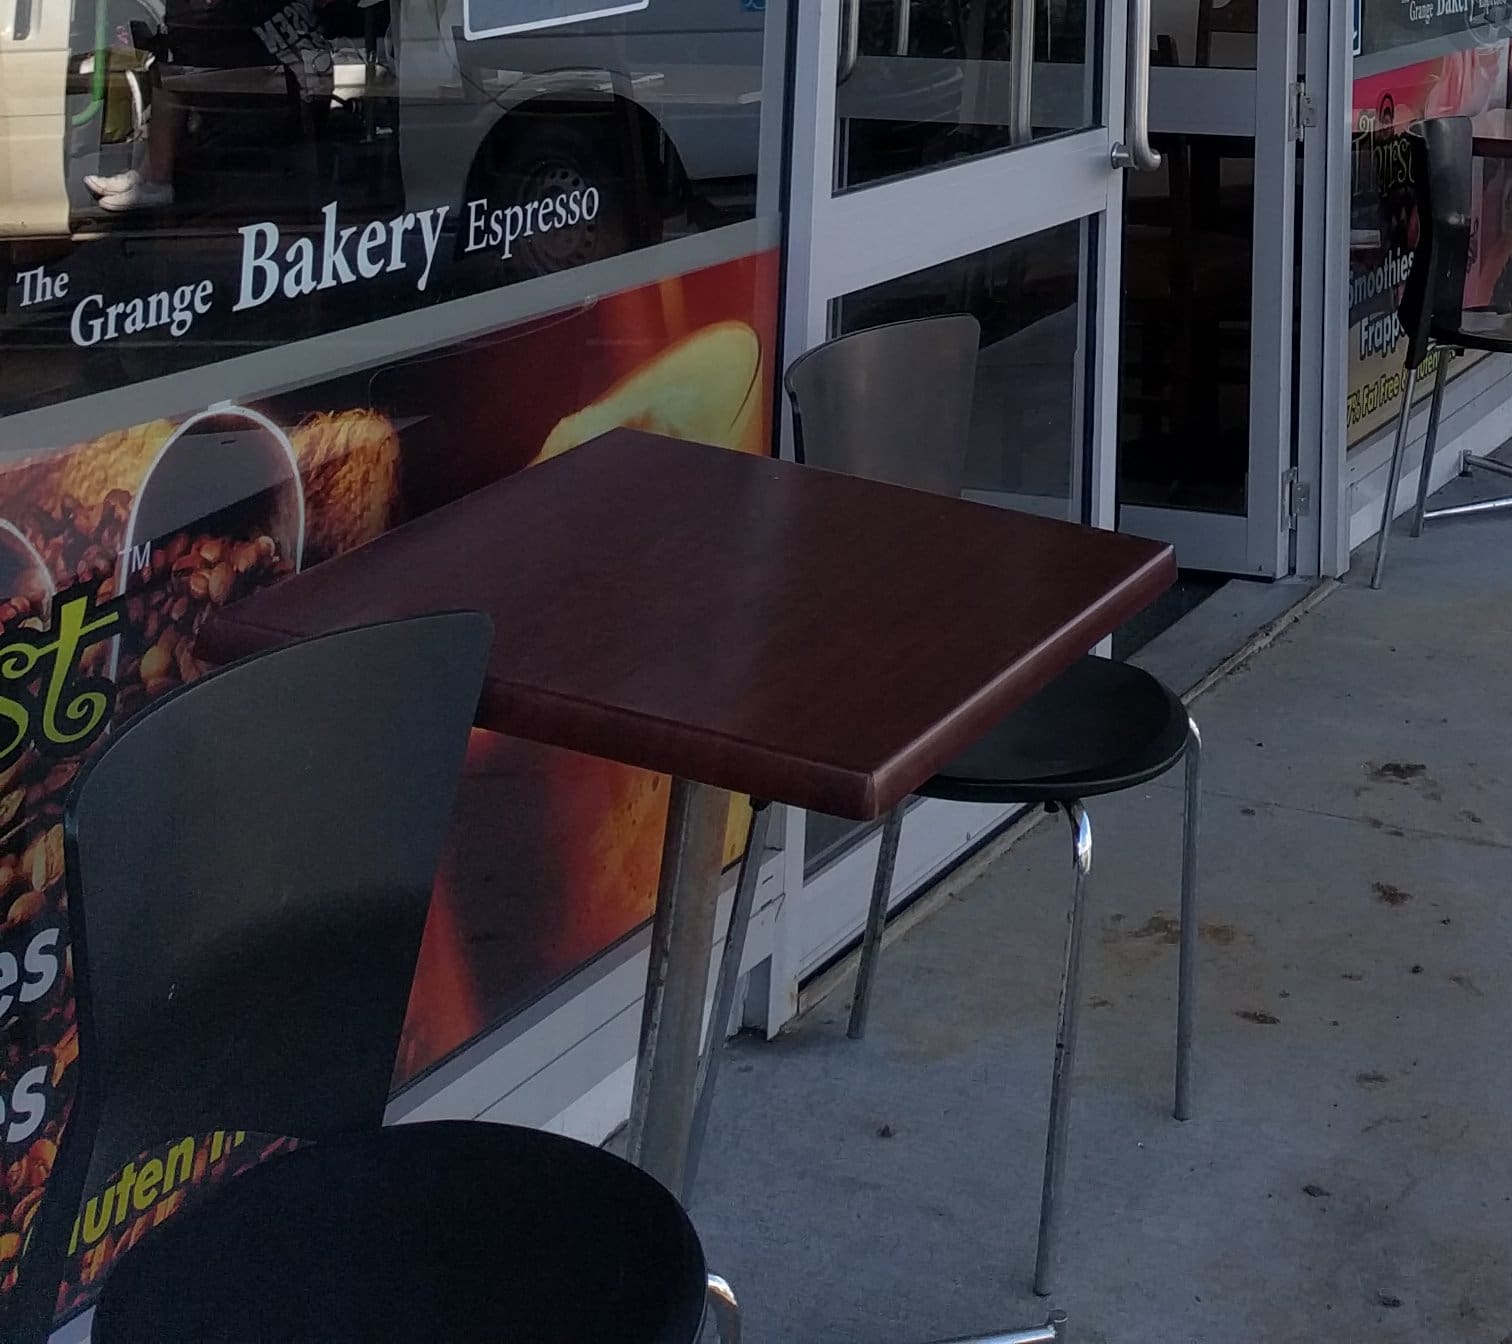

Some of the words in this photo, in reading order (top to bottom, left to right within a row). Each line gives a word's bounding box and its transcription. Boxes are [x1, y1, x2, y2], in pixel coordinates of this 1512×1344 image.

[1410, 0, 1434, 24] Grange
[16, 265, 69, 309] The
[70, 279, 214, 347] Grange
[232, 201, 450, 312] Bakery
[465, 186, 599, 259] Espresso
